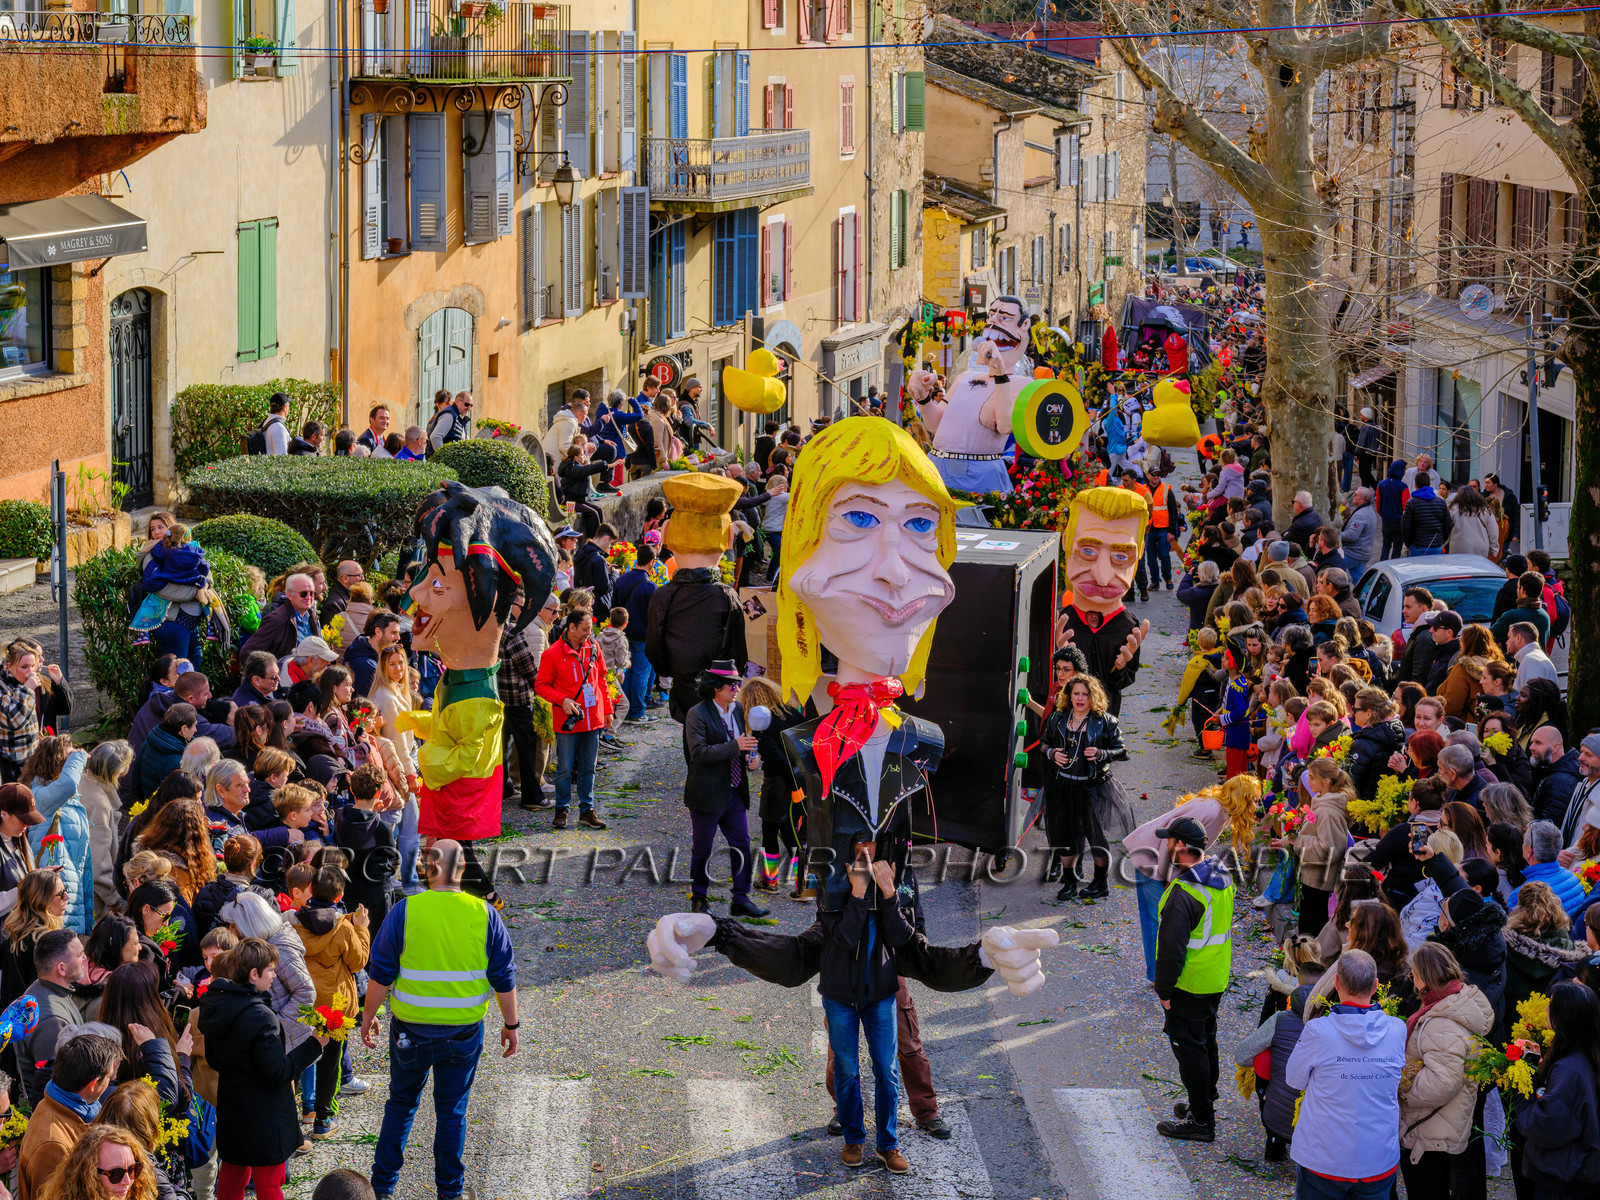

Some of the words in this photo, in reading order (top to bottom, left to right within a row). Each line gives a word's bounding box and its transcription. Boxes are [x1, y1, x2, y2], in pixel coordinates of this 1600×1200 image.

[60, 238, 88, 250] MAGREY
[89, 237, 95, 246] &
[95, 235, 112, 245] SONS
[657, 365, 670, 382] B
[1336, 1055, 1361, 1063] Réserve
